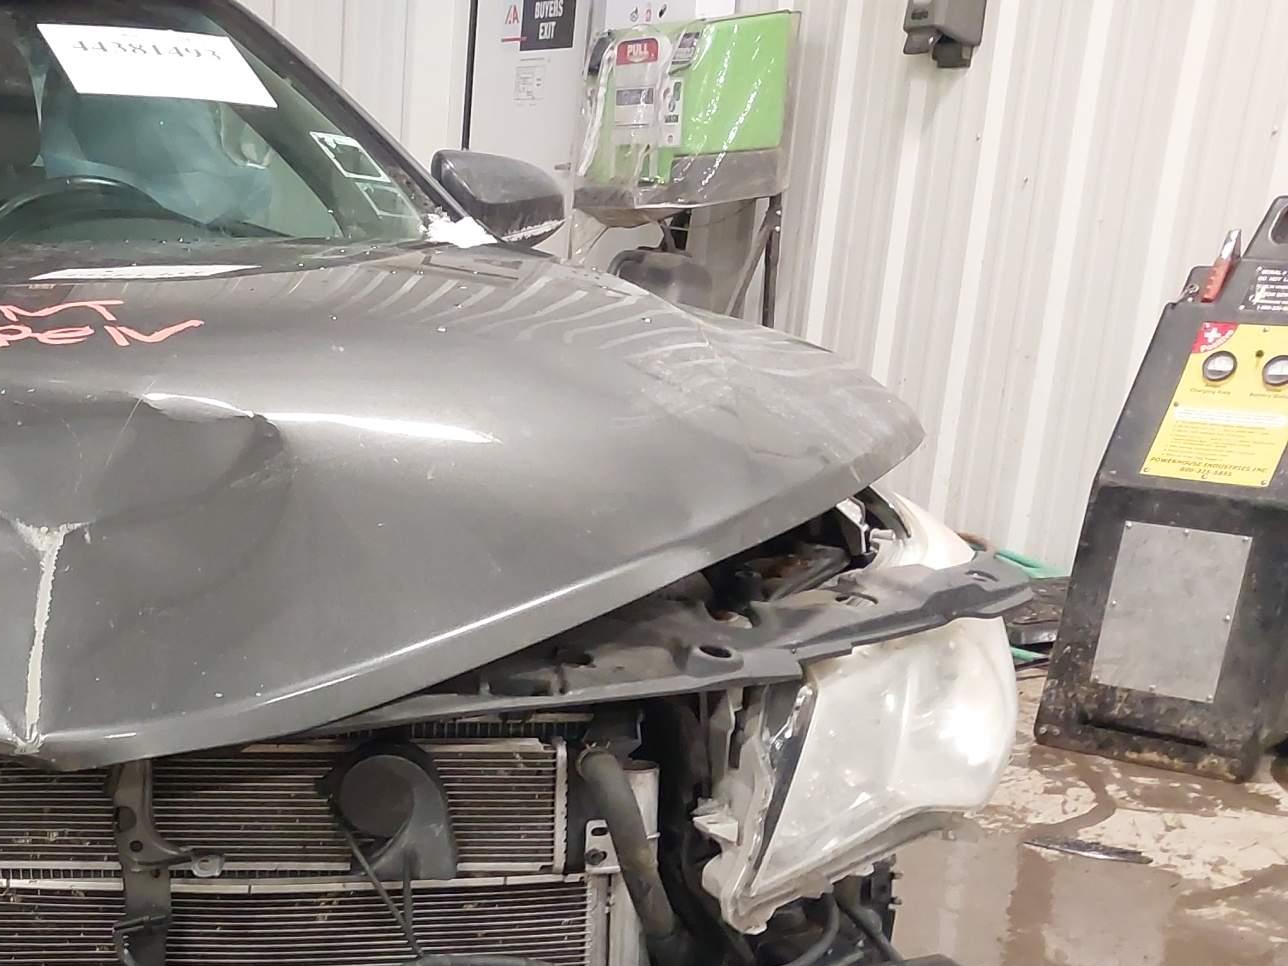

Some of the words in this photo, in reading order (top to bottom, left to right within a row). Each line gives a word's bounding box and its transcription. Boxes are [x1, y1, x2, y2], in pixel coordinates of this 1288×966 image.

[534, 0, 564, 18] BUYERS
[539, 21, 556, 39] EXIT
[73, 40, 222, 61] 44381493
[626, 42, 650, 56] PULL
